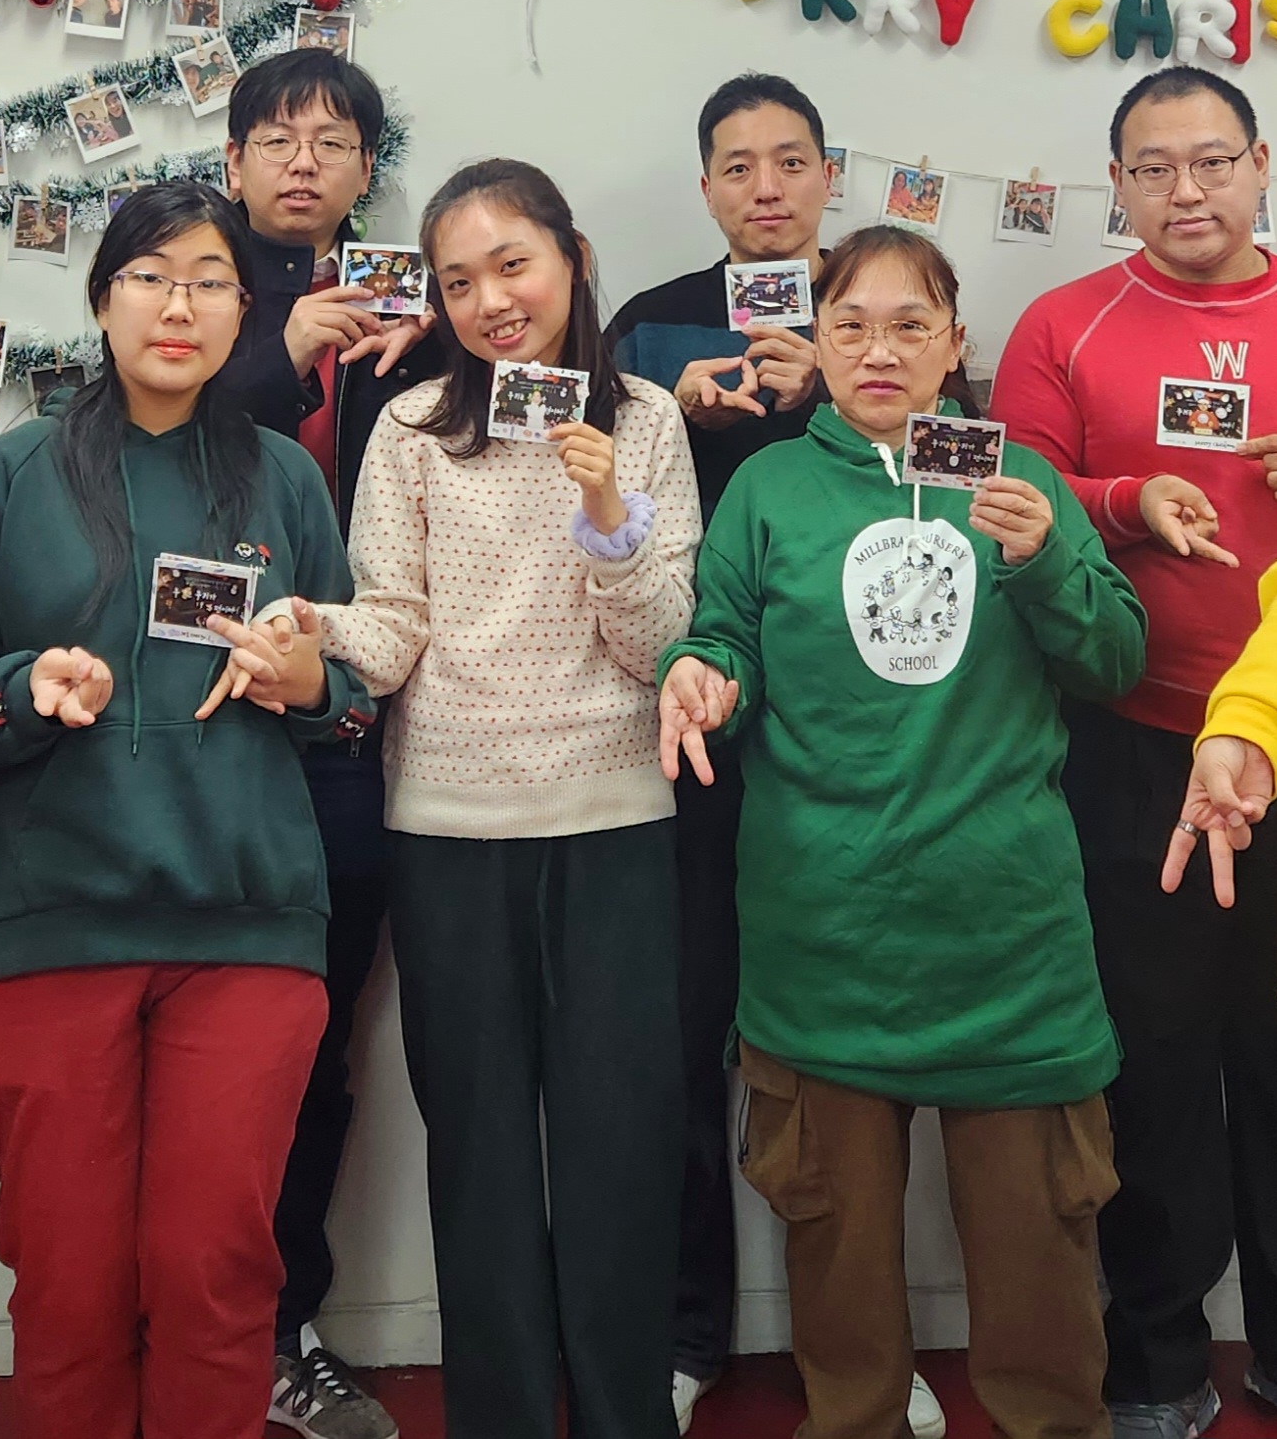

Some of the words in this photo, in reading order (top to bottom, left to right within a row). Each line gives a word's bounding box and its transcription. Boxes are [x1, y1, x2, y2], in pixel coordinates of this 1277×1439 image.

[1199, 341, 1249, 380] W
[853, 535, 912, 566] MILLBRA
[919, 532, 969, 561] URSERY
[889, 655, 939, 673] SCHOOL
